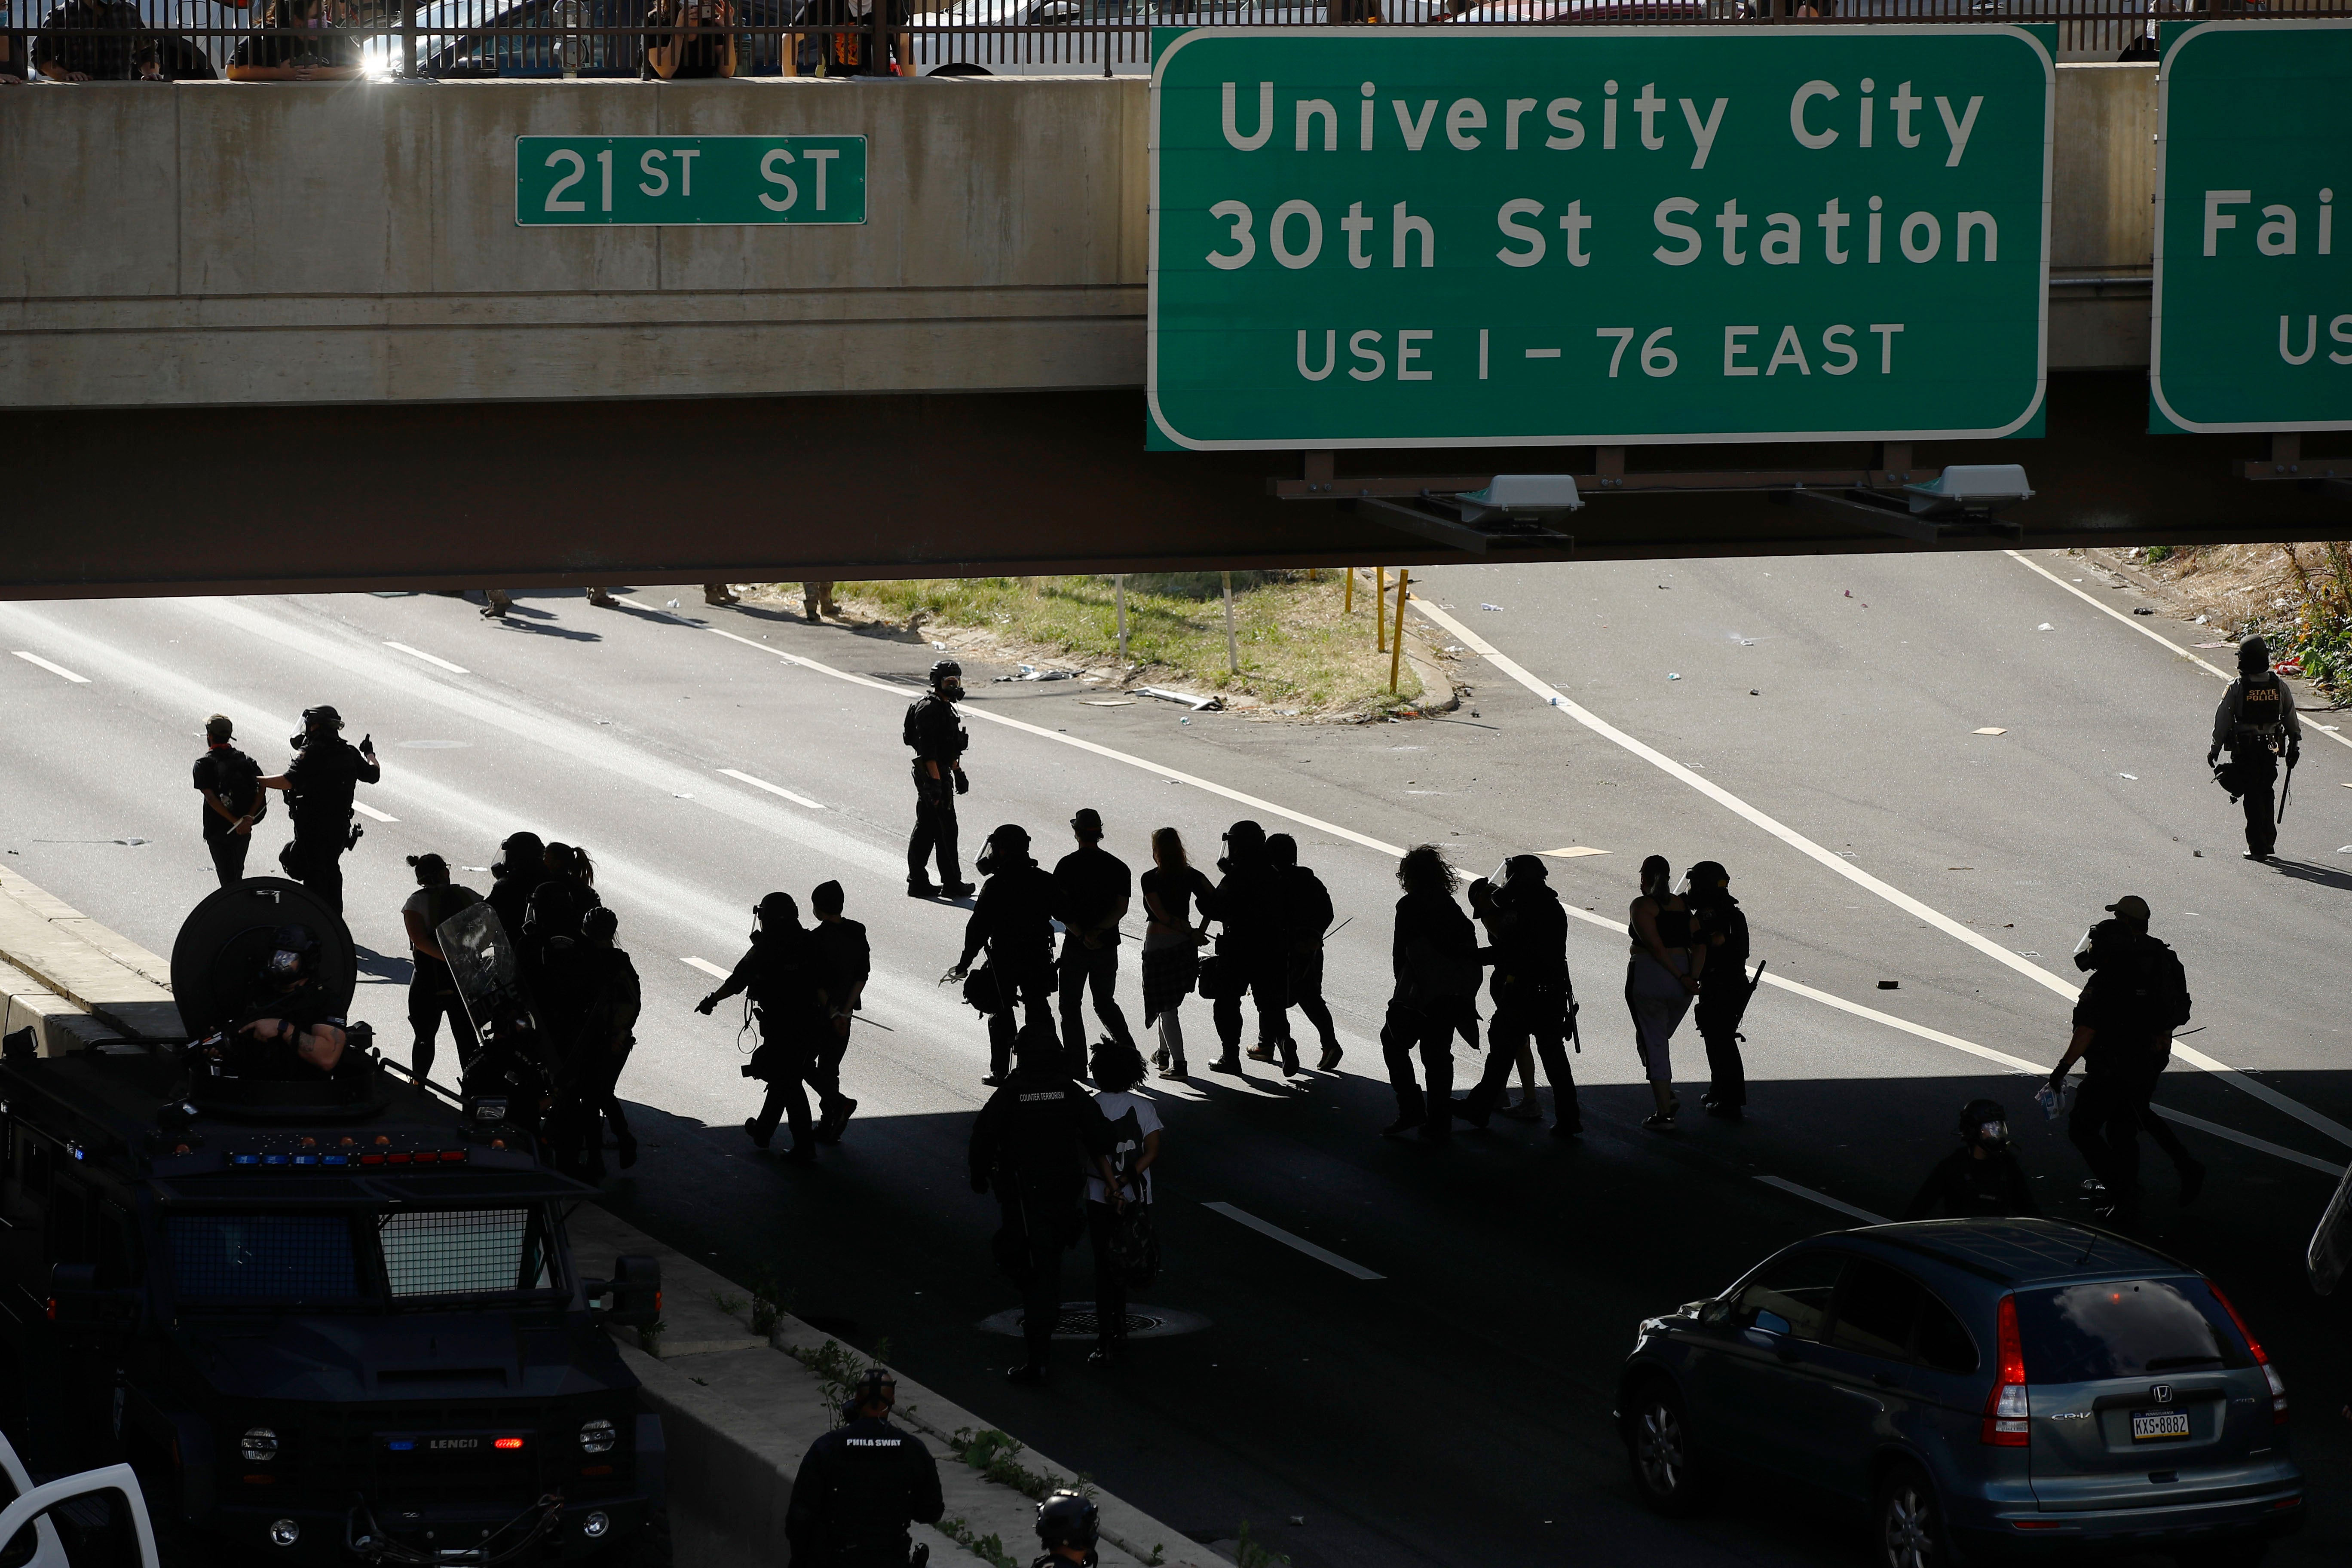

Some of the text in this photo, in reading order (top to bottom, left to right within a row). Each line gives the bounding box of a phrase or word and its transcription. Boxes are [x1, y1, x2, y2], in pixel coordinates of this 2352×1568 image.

[1222, 77, 1984, 170] University City
[757, 148, 840, 211] ST
[1205, 195, 1998, 270] 30th St Station
[2203, 187, 2334, 257] Fai
[1297, 329, 1433, 381] USE
[1724, 324, 1905, 377] EAST
[1020, 1091, 1065, 1102] COUNTER TERRORISM
[430, 1439, 478, 1449] LENCO
[2051, 1412, 2091, 1420] CR-V
